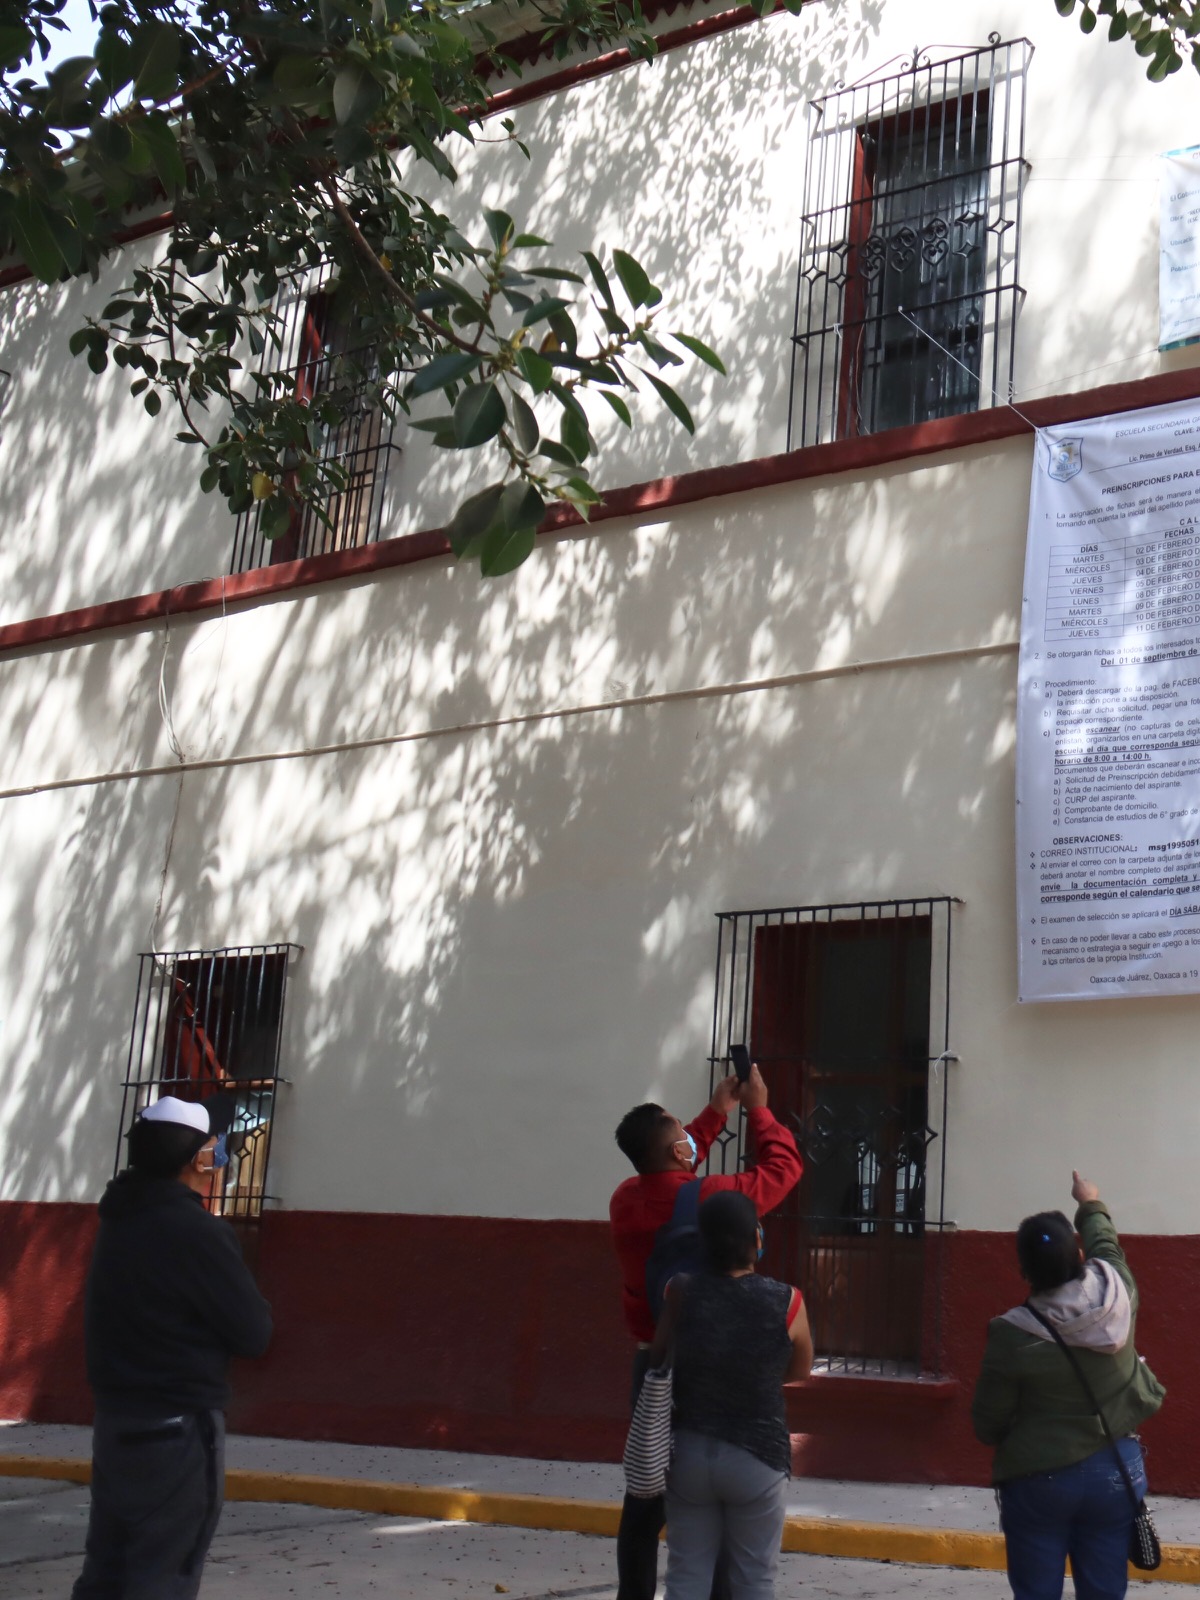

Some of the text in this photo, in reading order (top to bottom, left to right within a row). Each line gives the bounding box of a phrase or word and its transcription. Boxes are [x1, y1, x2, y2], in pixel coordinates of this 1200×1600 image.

[1116, 428, 1146, 438] ESCUELA
[1140, 452, 1156, 461] Primo
[1102, 475, 1171, 495] PREINSCRIPCIONES
[1173, 471, 1194, 481] PARA
[1069, 507, 1103, 520] asignación
[1117, 501, 1135, 511] fichas
[1139, 497, 1152, 505] será
[1155, 494, 1163, 502] de
[1167, 490, 1192, 500] manera
[1056, 518, 1086, 528] tomando
[1098, 514, 1118, 523] cuenta
[1128, 509, 1146, 517] inicial
[1158, 500, 1183, 512] apellido
[1164, 527, 1194, 538] FECHAS
[1080, 544, 1098, 553] DÍAS
[1158, 538, 1192, 550] FEBRERO
[1073, 555, 1104, 563] MARTES
[1158, 549, 1192, 562] FEBRERO
[1065, 564, 1110, 574] MIÉRCOLES
[1158, 561, 1192, 573] FEBRERO
[1072, 576, 1102, 584] JUEVES
[1070, 586, 1104, 595] VIERNES
[1158, 606, 1192, 618] FEBRERO
[1062, 618, 1108, 627] MIÉRCOLES
[1158, 617, 1192, 629] FEBRERO
[1058, 650, 1092, 658] otorgarán
[1156, 638, 1194, 651] interesados
[1143, 651, 1186, 663] septiembre
[1045, 679, 1096, 688] Procedimiento:
[1058, 688, 1083, 697] Deberá
[1086, 687, 1121, 696] descargar
[1130, 741, 1178, 751] corresponda
[1054, 762, 1144, 775] Documentos deberán
[1065, 771, 1159, 784] Solicitud Preinscripción
[1094, 782, 1132, 792] nacimiento
[1064, 805, 1112, 815] Comprobante
[1064, 811, 1146, 825] Constancia estudios
[1053, 834, 1123, 846] OBSERVACIONES:
[1040, 850, 1072, 858] CORREO
[1075, 845, 1137, 855] INSTITUCIONAL:
[1084, 878, 1146, 889] documentación
[1153, 874, 1188, 886] completa
[1040, 889, 1090, 903] corresponde
[1130, 886, 1174, 897] calendario
[1087, 913, 1119, 921] selección
[1173, 928, 1200, 937] proceso
[1042, 947, 1079, 956] mecanismo
[1090, 975, 1115, 984] Oaxaca
[1154, 971, 1180, 980] Oaxaca
